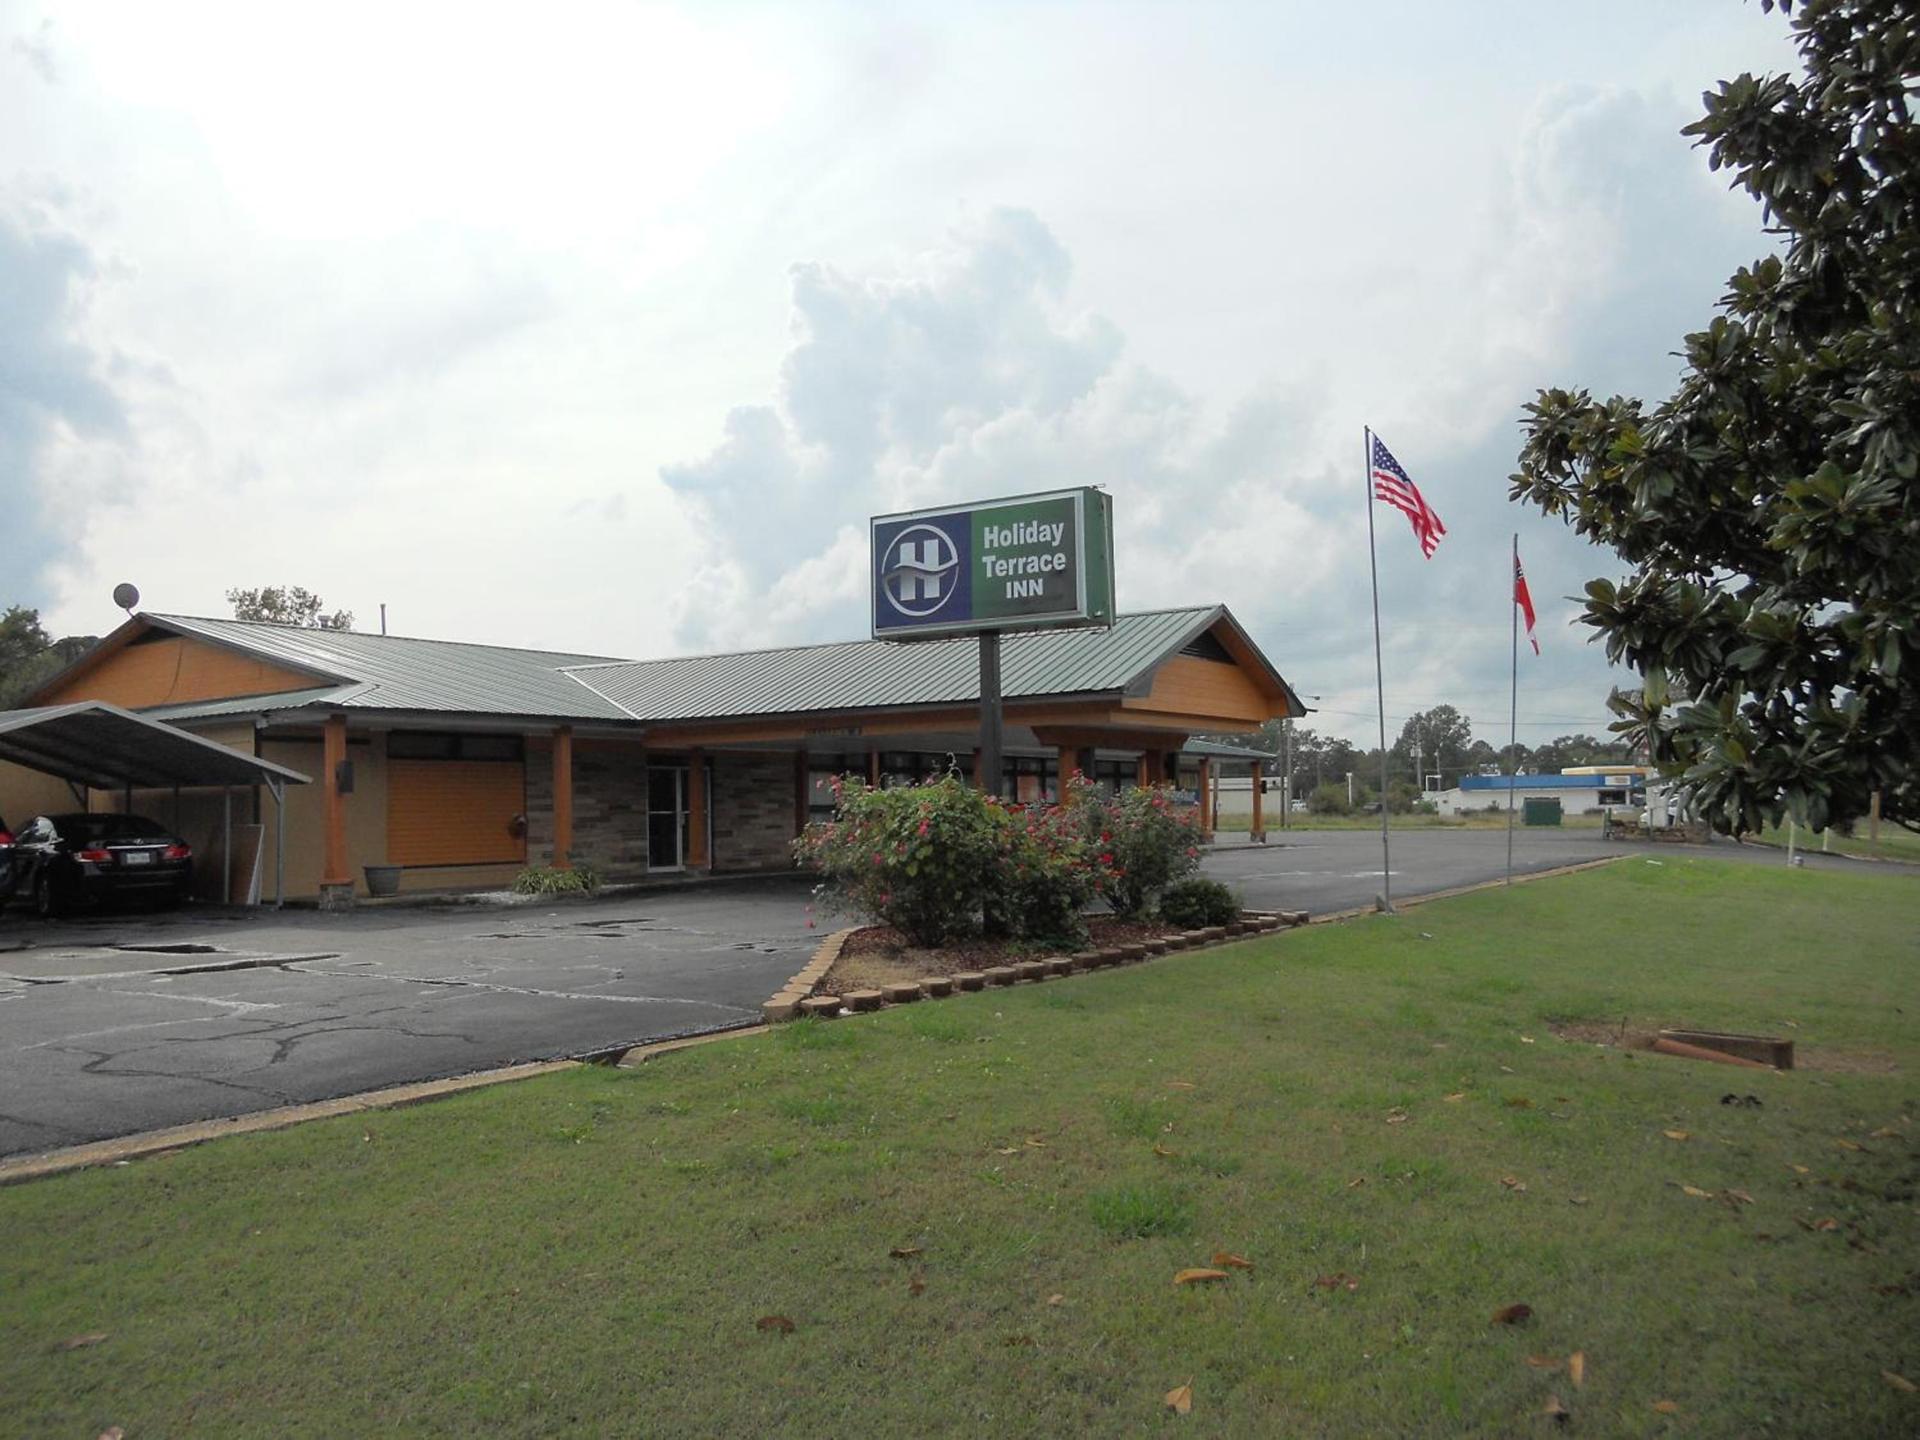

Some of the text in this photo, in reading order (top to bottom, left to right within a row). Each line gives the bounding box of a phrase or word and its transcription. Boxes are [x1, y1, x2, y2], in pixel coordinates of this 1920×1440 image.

[983, 520, 1065, 549] Holiday
[982, 552, 1066, 578] Terrace
[1005, 578, 1044, 599] INN
